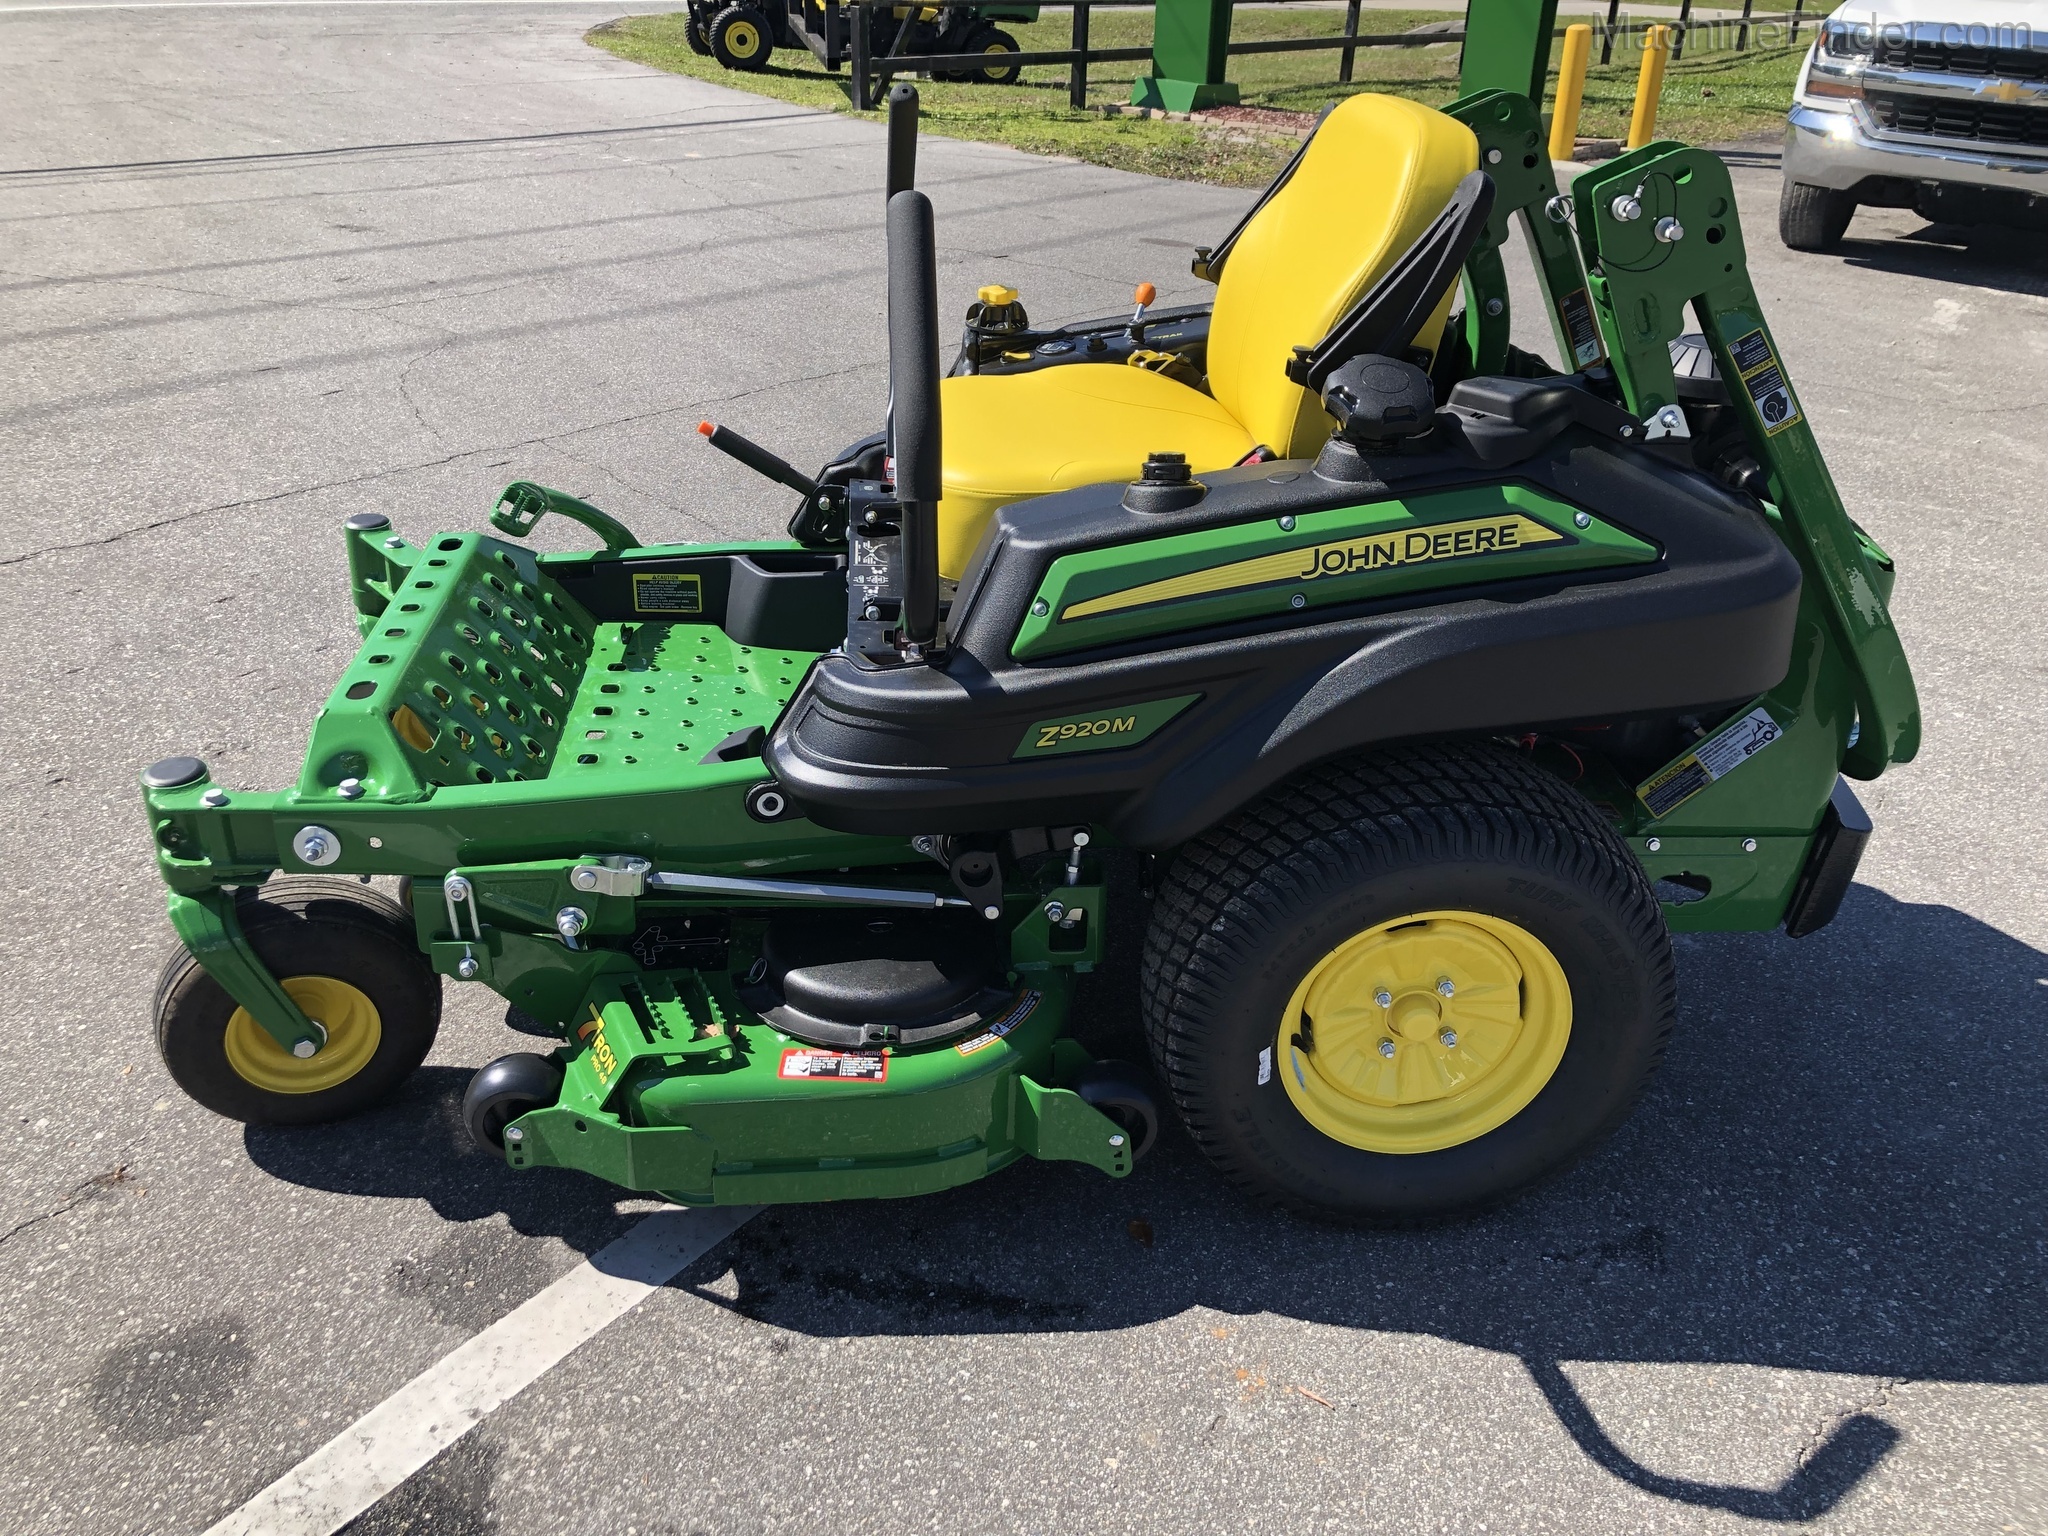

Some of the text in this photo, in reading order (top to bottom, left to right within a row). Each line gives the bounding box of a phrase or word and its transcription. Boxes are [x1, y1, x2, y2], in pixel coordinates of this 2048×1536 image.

[1768, 417, 1794, 435] CAUTION
[1301, 524, 1518, 576] JOHN DEERE
[1035, 715, 1136, 748] Z920M
[1504, 876, 1584, 914] TURF
[590, 1053, 608, 1085] PRO 48
